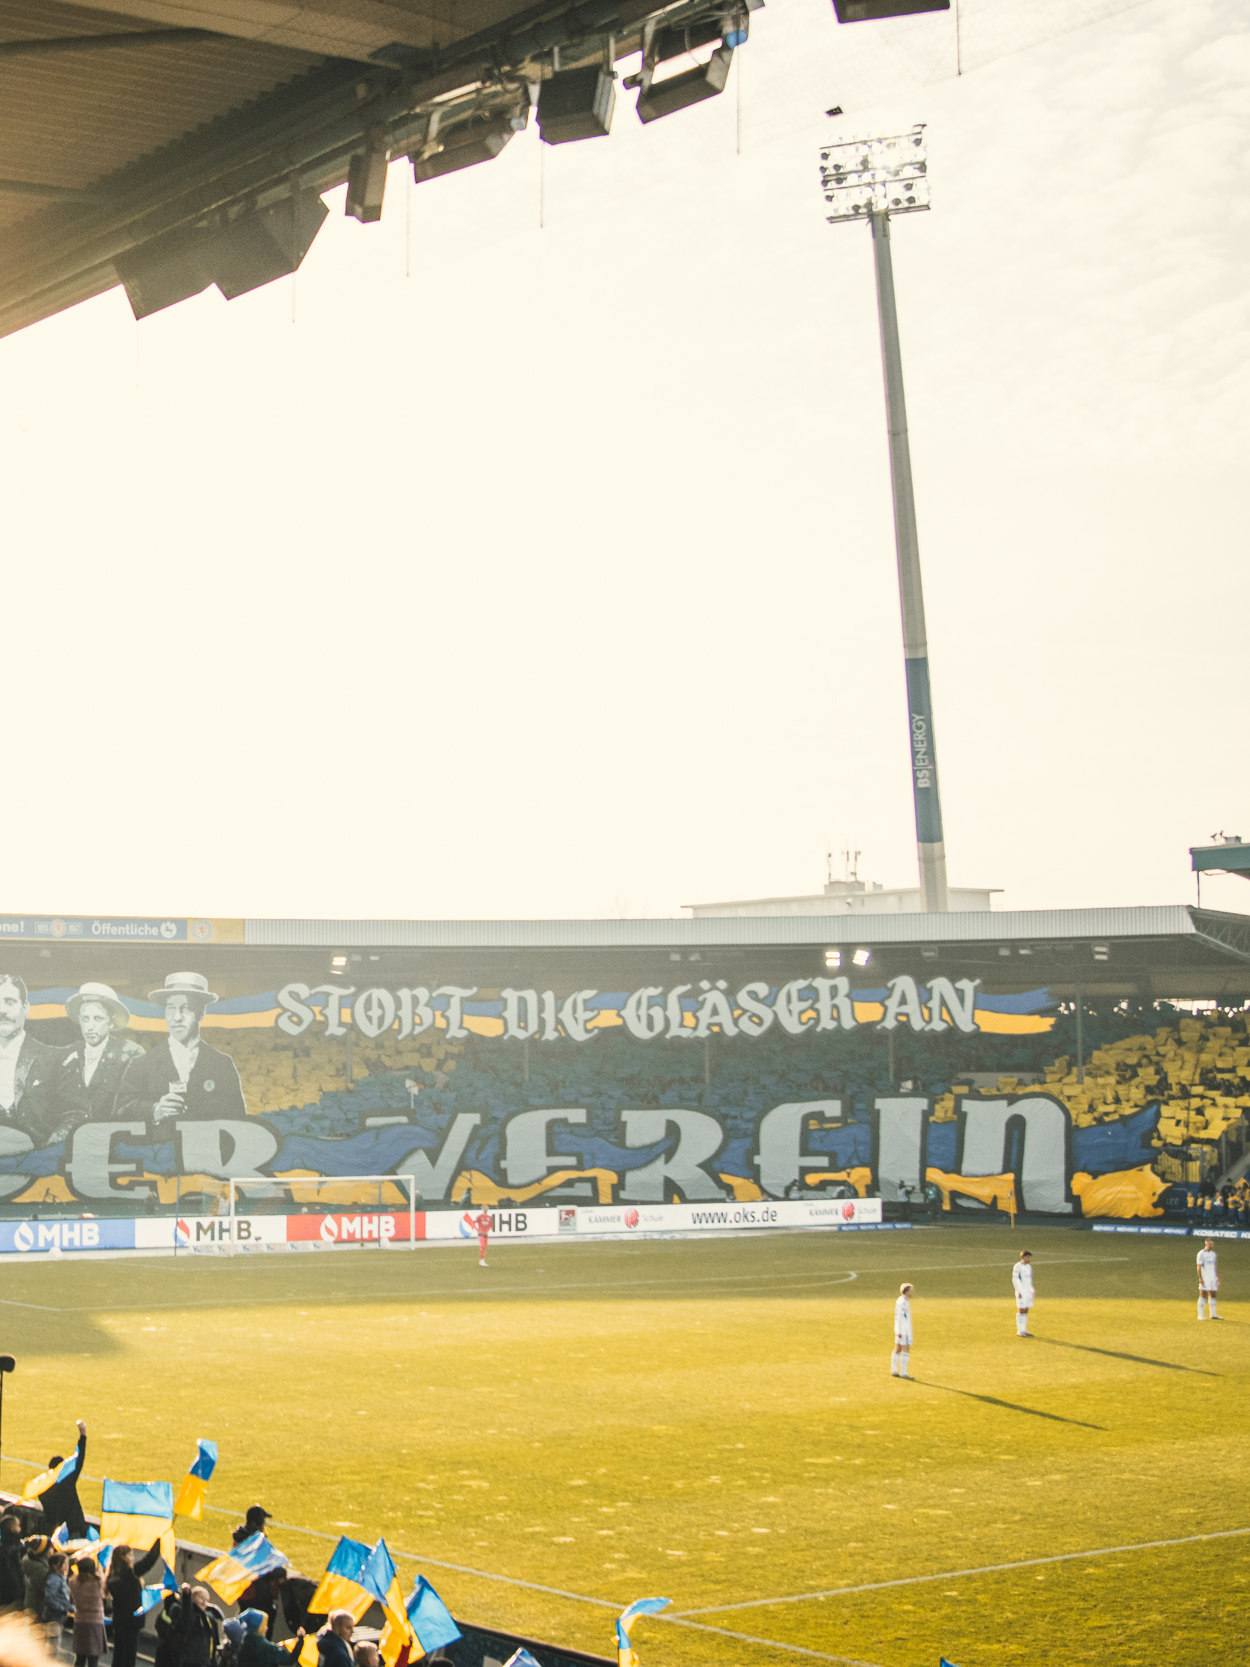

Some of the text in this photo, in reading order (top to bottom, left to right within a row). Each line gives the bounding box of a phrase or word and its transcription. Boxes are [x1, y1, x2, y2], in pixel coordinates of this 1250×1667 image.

[91, 920, 159, 936] Öffentliche
[500, 986, 599, 1041] DIE
[619, 975, 858, 1041] GLÄSER
[875, 974, 982, 1034] AN
[341, 1215, 396, 1239] MHB
[691, 1208, 777, 1225] www.oks.de
[38, 1222, 100, 1247] MHB
[195, 1220, 251, 1241] MHB
